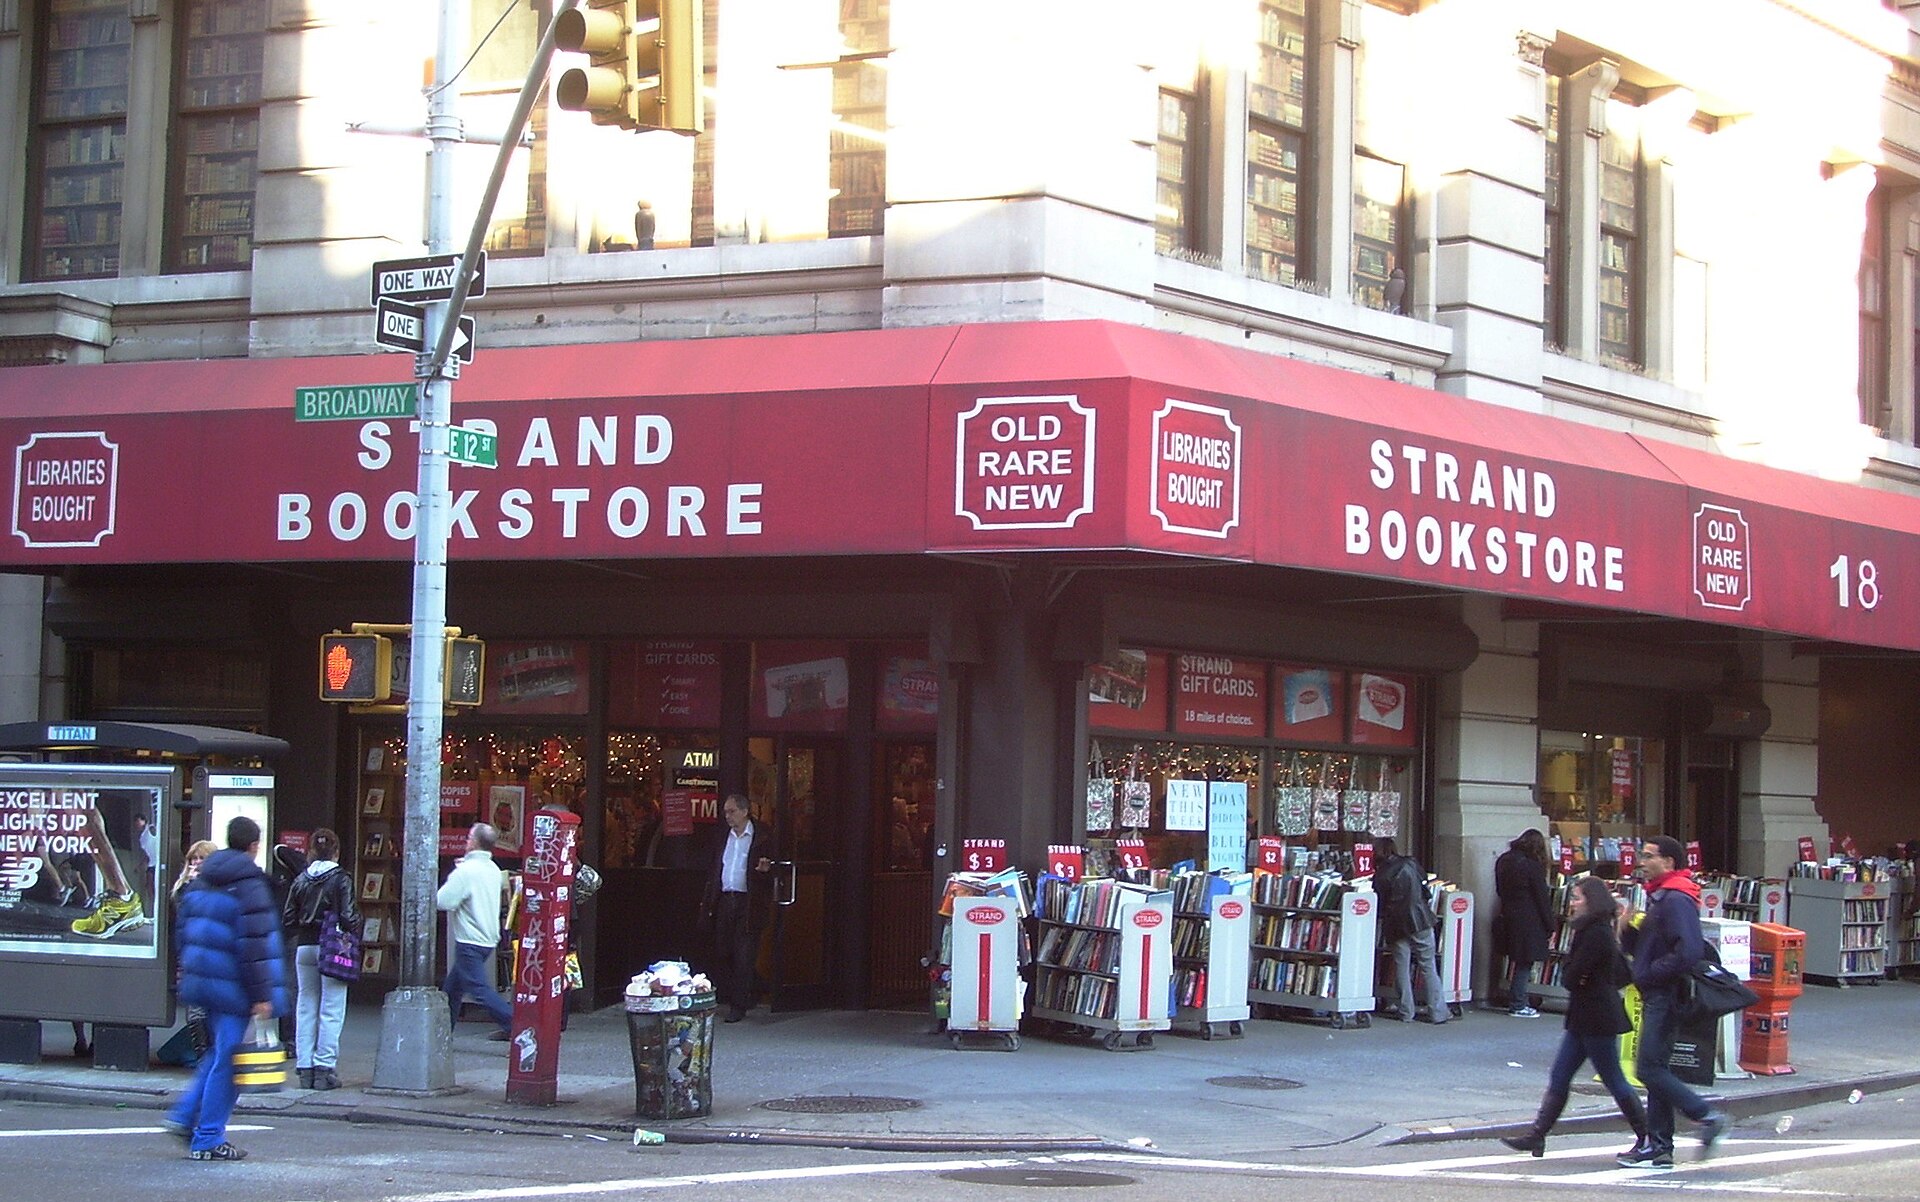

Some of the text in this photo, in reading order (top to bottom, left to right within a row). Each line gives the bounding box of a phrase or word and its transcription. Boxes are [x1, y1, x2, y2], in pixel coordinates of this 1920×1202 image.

[384, 267, 455, 292] ONE WAY
[387, 315, 415, 336] ONE
[303, 386, 410, 417] BROADWAY
[990, 415, 1062, 442] OLD
[357, 413, 674, 471] SAND
[450, 431, 492, 461] E 12 ST
[1162, 430, 1231, 471] LIBRARIES
[27, 458, 106, 486] LIBRARIES
[978, 449, 1073, 477] RARE
[1369, 438, 1556, 519] STRAND
[985, 484, 1064, 511] NEW
[1167, 472, 1223, 509] BOUGHT
[32, 495, 96, 522] BOUGHT
[277, 482, 764, 541] BOOKSTORE
[1707, 519, 1736, 543] OLD
[1345, 503, 1625, 592] BOOKSTORE
[1702, 545, 1743, 570] RARE
[1706, 572, 1739, 595] NEW
[645, 653, 673, 665] GIFT
[1181, 655, 1233, 675] STRAND
[902, 677, 938, 694] STRAN
[1181, 675, 1258, 698] GIFT CARDS.
[1185, 710, 1195, 722] 18
[1196, 711, 1216, 723] miles
[1217, 712, 1225, 723] of
[53, 727, 92, 740] TITAN
[683, 752, 713, 767] ATM
[231, 777, 253, 787] TITAN
[1170, 783, 1203, 798] NEW
[690, 798, 718, 819] TM
[1169, 800, 1204, 814] THIS
[1211, 792, 1246, 807] JOAN
[0, 812, 88, 832] IGHTS UP
[1169, 815, 1205, 827] WEEK
[41, 834, 99, 854] YORK.
[964, 839, 1005, 848] STRAND
[1048, 845, 1082, 855] STRAND
[1115, 839, 1145, 847] STRAND
[1211, 834, 1247, 849] BLUE
[1265, 851, 1277, 863] $2
[1358, 856, 1370, 872] $2
[968, 911, 1003, 921] STRAND
[1135, 914, 1161, 924] STRAND
